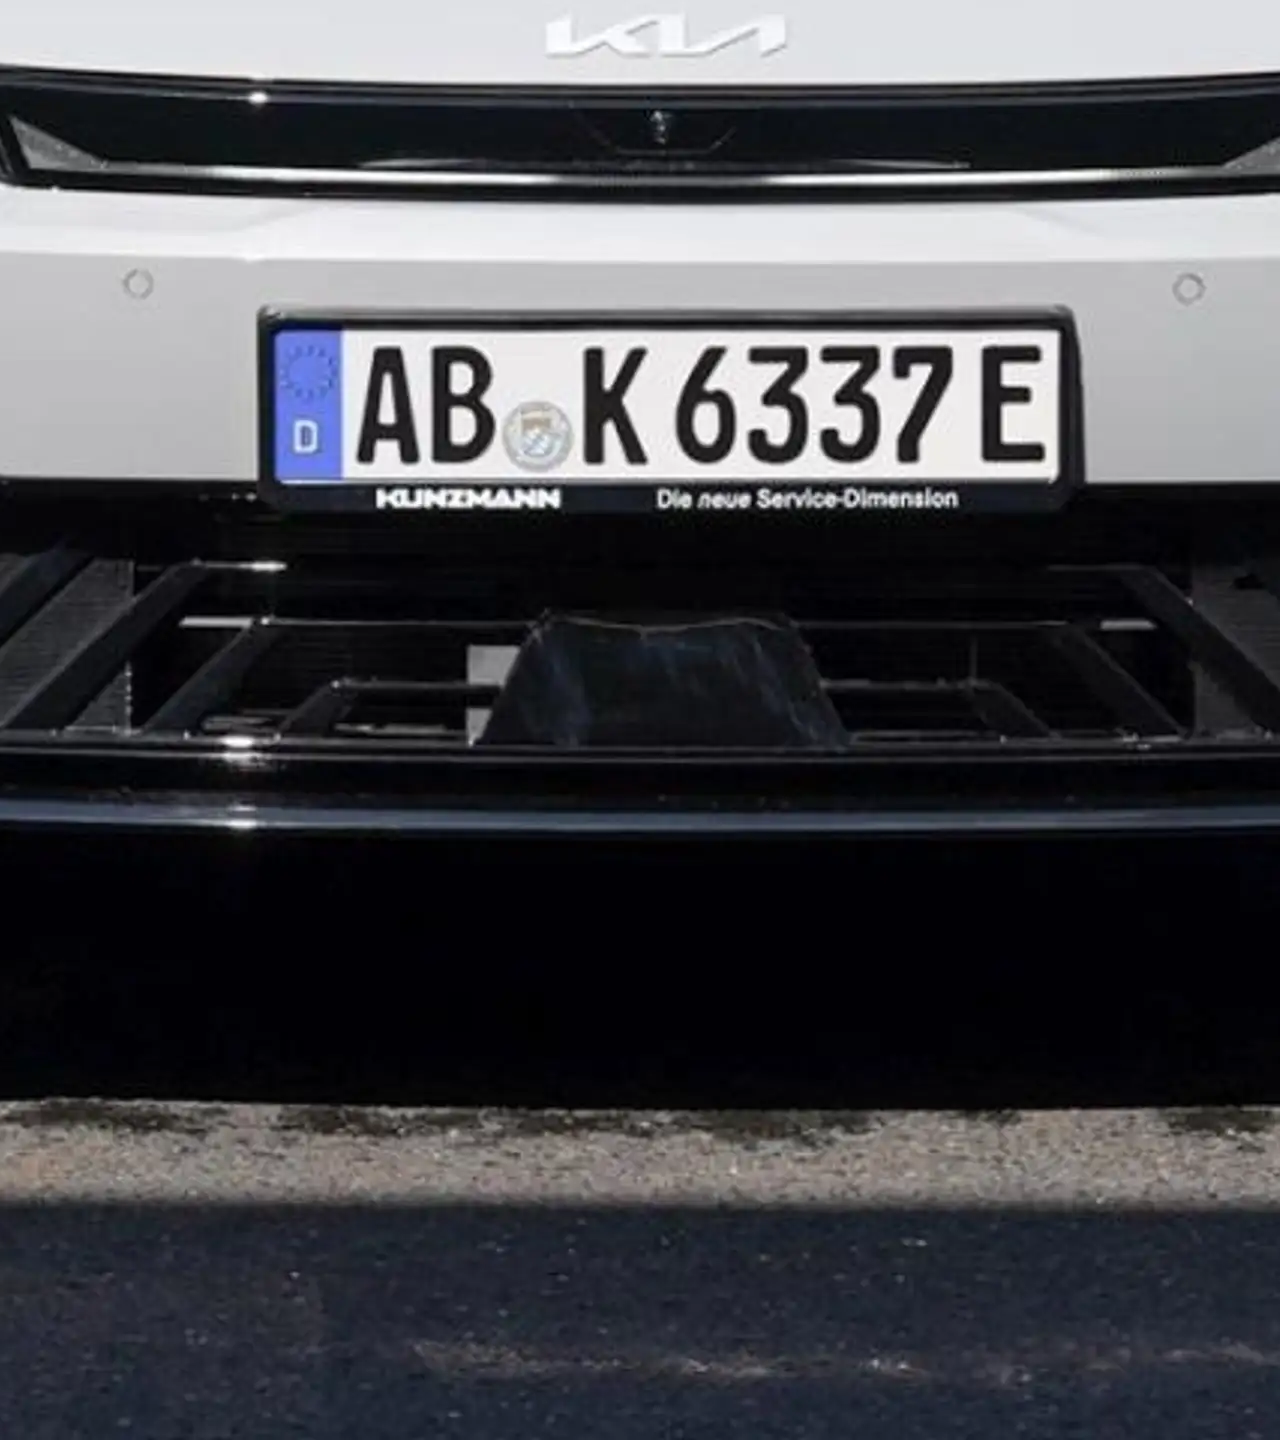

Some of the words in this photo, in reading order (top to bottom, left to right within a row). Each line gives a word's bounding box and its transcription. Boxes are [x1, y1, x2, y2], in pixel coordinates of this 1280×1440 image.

[356, 346, 496, 465] AB
[583, 346, 648, 465] K
[292, 418, 319, 454] D
[375, 487, 562, 509] KUNZMANN
[656, 487, 693, 509] Die
[697, 492, 753, 509] neue
[756, 486, 960, 509] Service-Dimension
